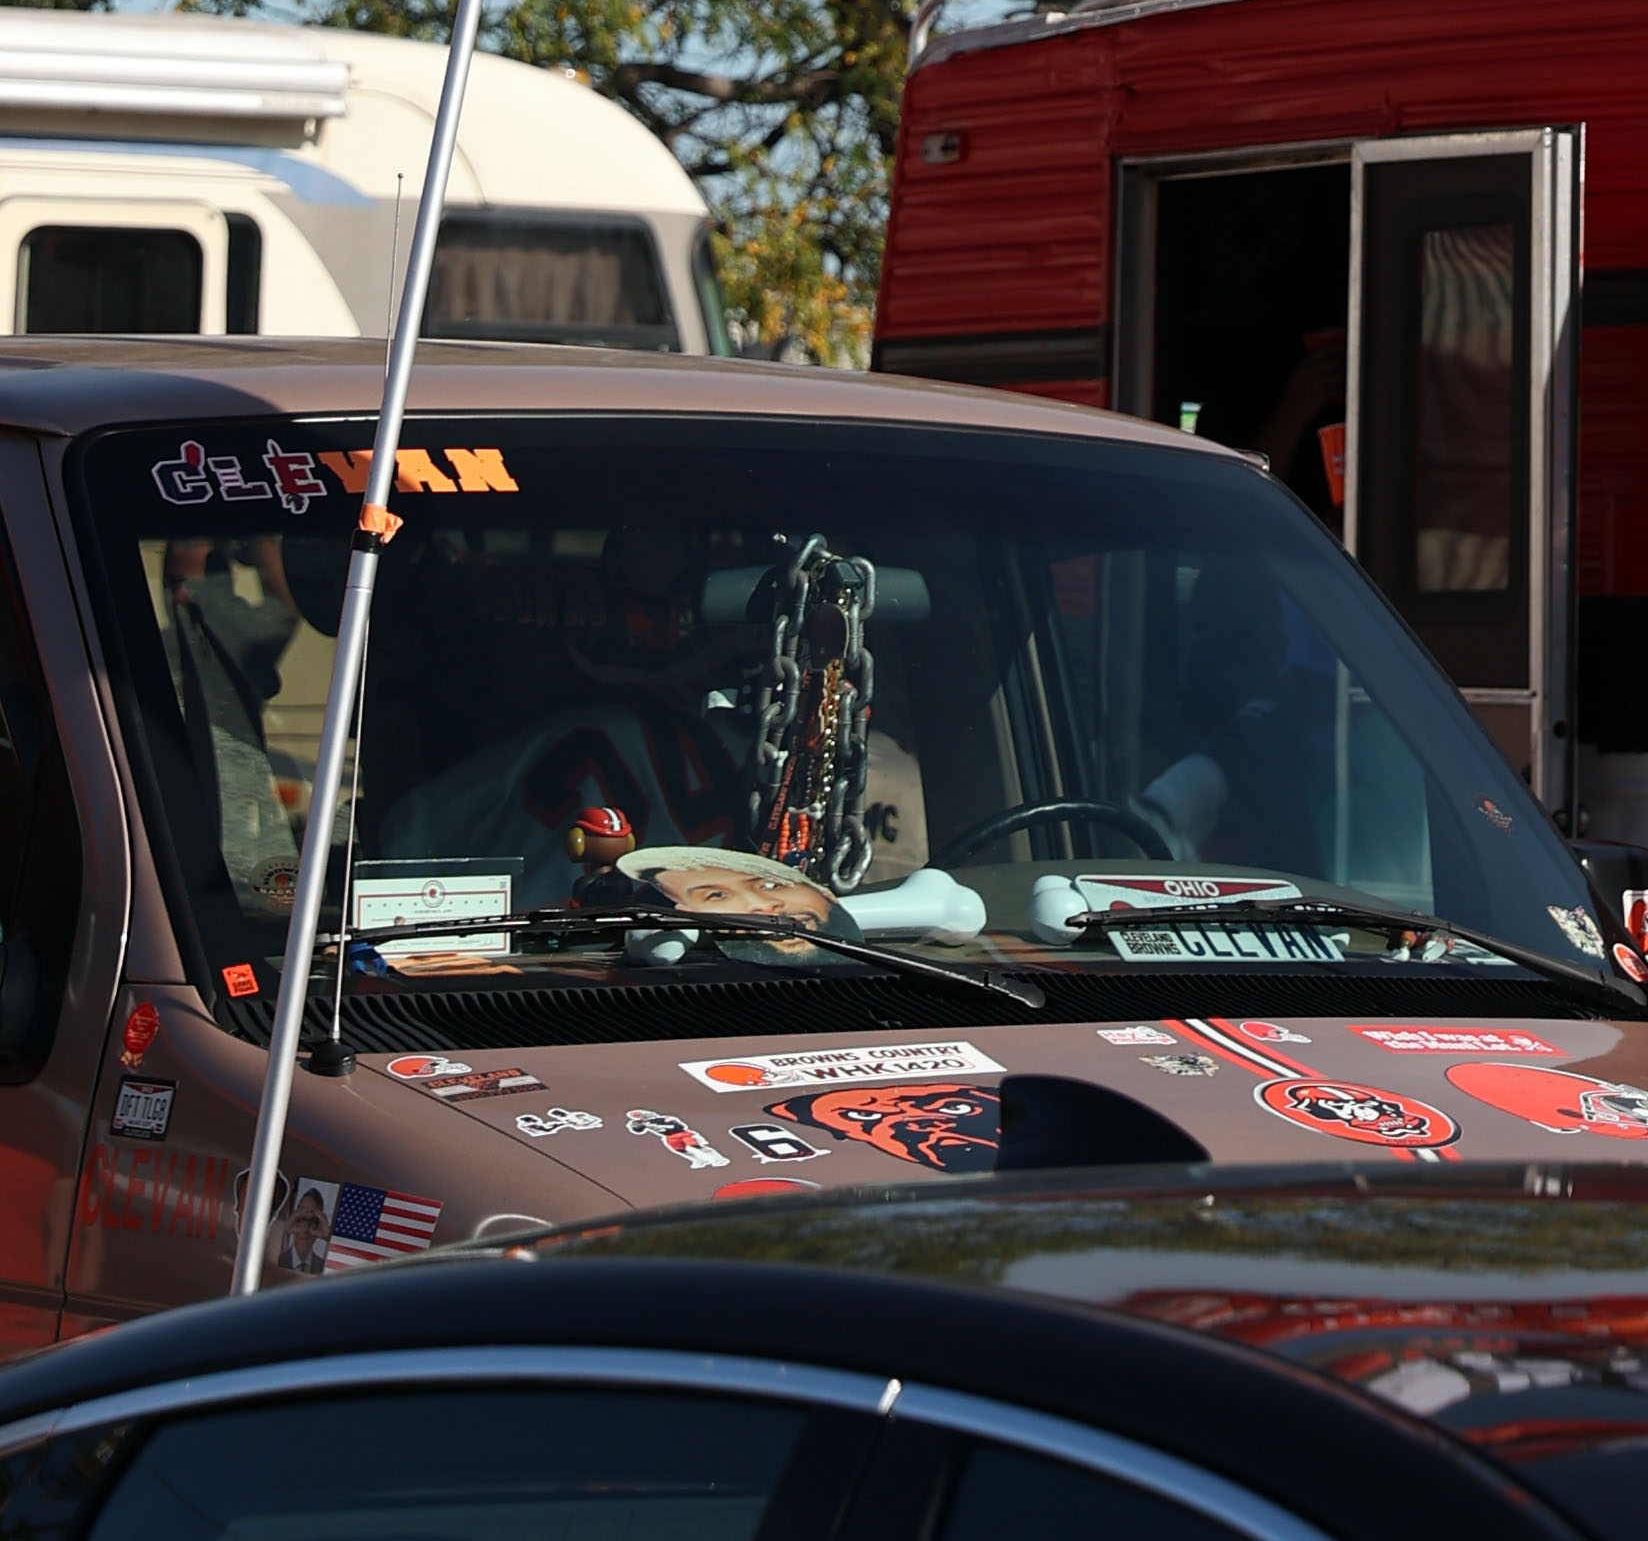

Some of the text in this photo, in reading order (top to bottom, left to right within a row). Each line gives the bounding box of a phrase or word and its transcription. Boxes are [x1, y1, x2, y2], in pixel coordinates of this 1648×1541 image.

[1163, 879, 1220, 898] OHIO
[1120, 931, 1174, 943] CLEVELAND
[1129, 943, 1182, 955] BROWNS
[769, 1043, 965, 1067] BROWNS COUNTRY
[799, 1058, 965, 1080] WHK 1420
[731, 1124, 817, 1160] 6
[81, 1143, 229, 1240] CLEVAN
